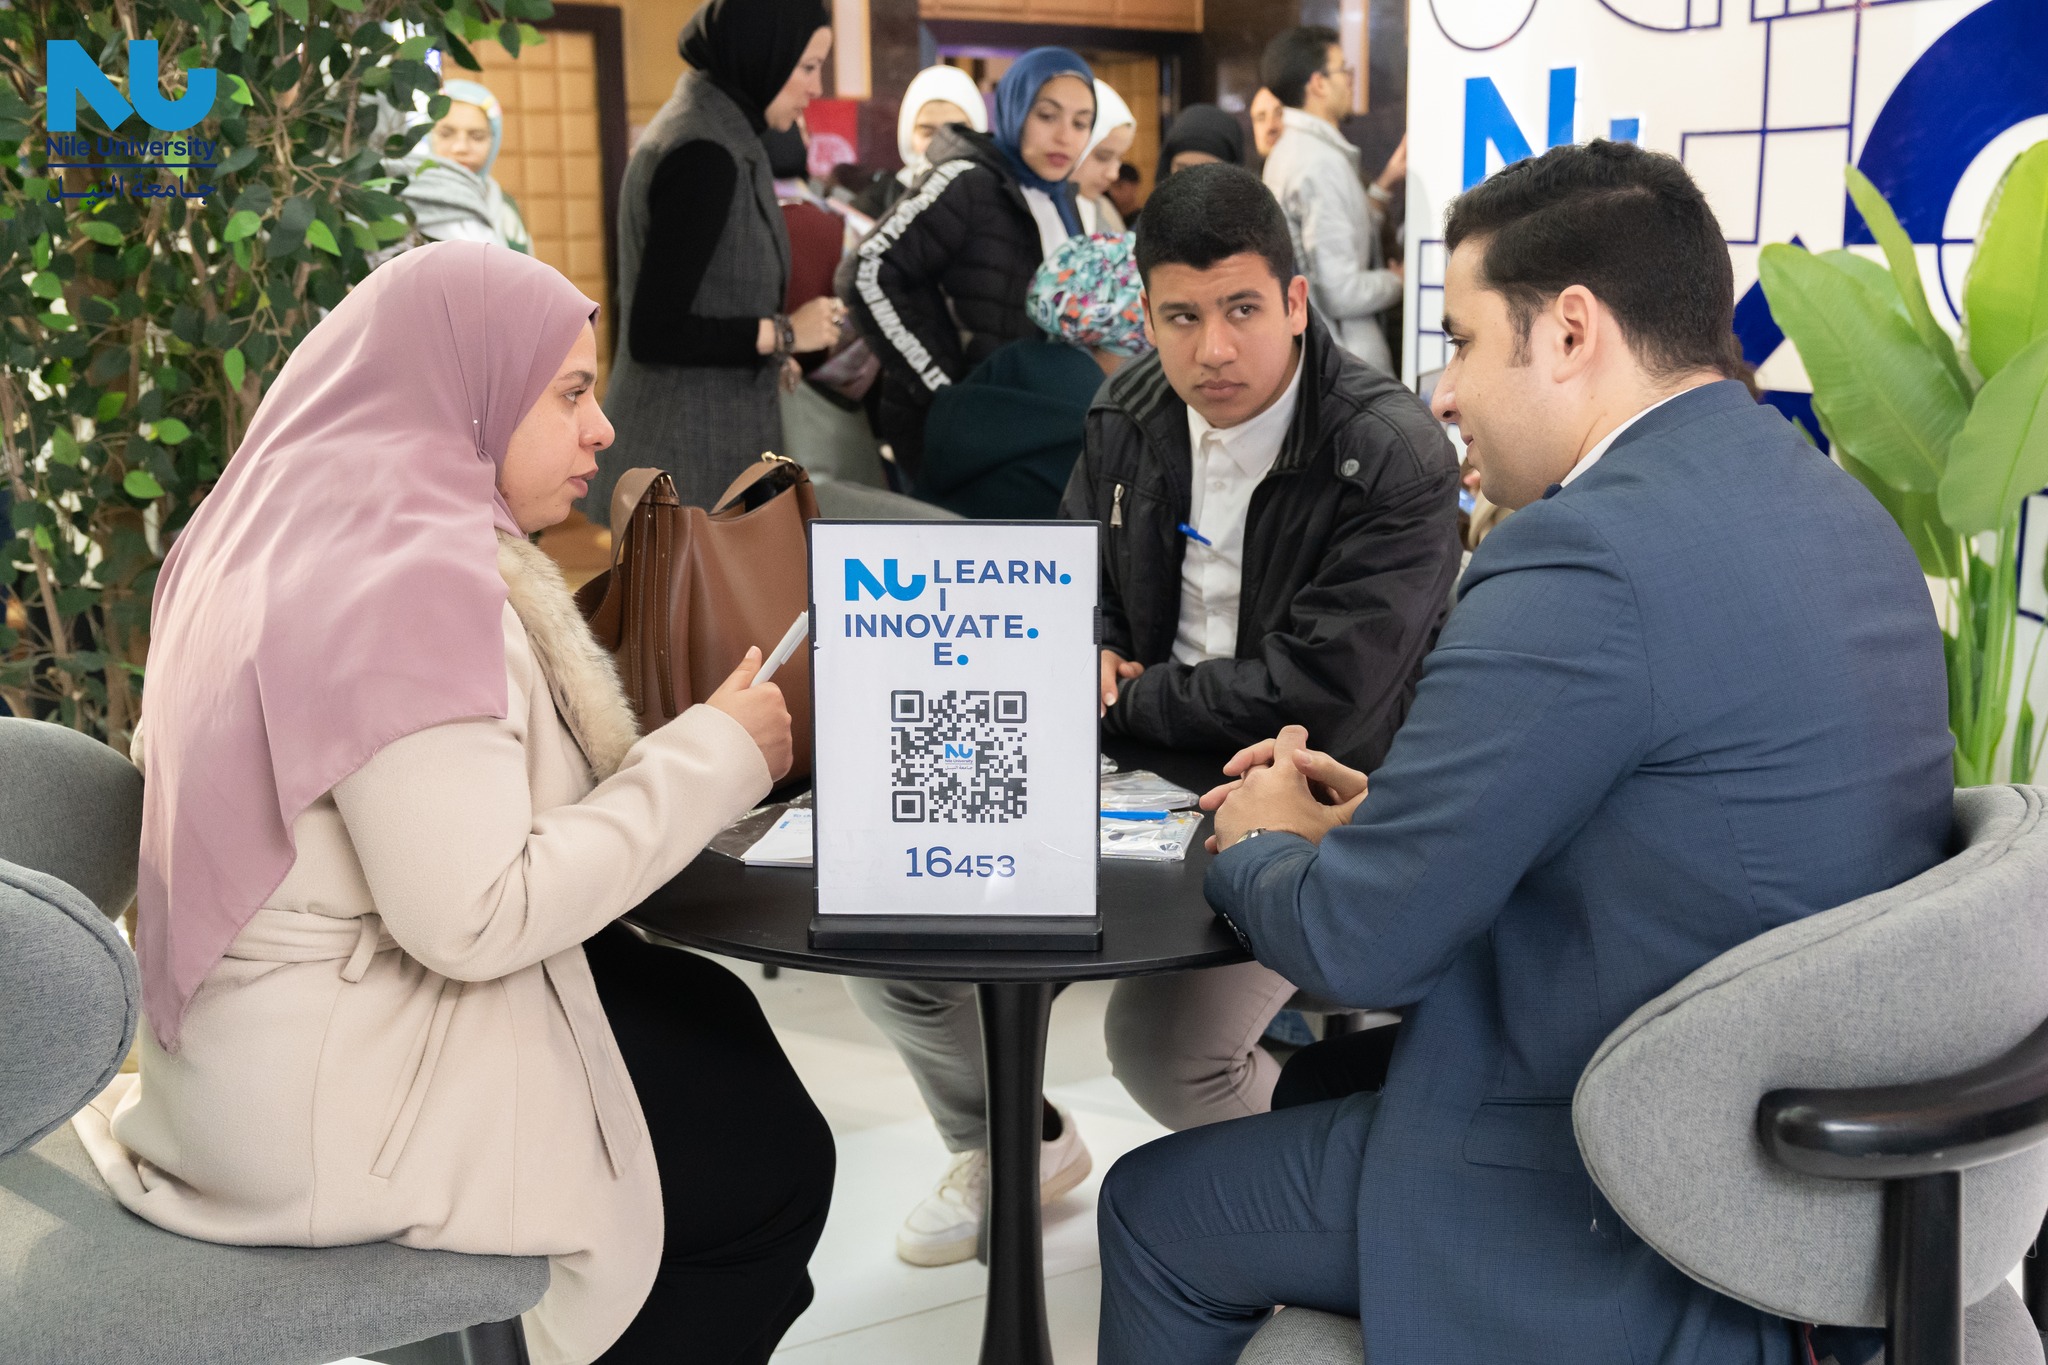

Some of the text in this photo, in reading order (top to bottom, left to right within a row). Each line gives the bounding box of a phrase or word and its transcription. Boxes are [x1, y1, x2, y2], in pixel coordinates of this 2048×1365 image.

[844, 558, 1072, 601] NU LEARN.
[844, 613, 1039, 640] INNOVATE.
[945, 743, 973, 759] NU
[906, 845, 1016, 878] 16453
